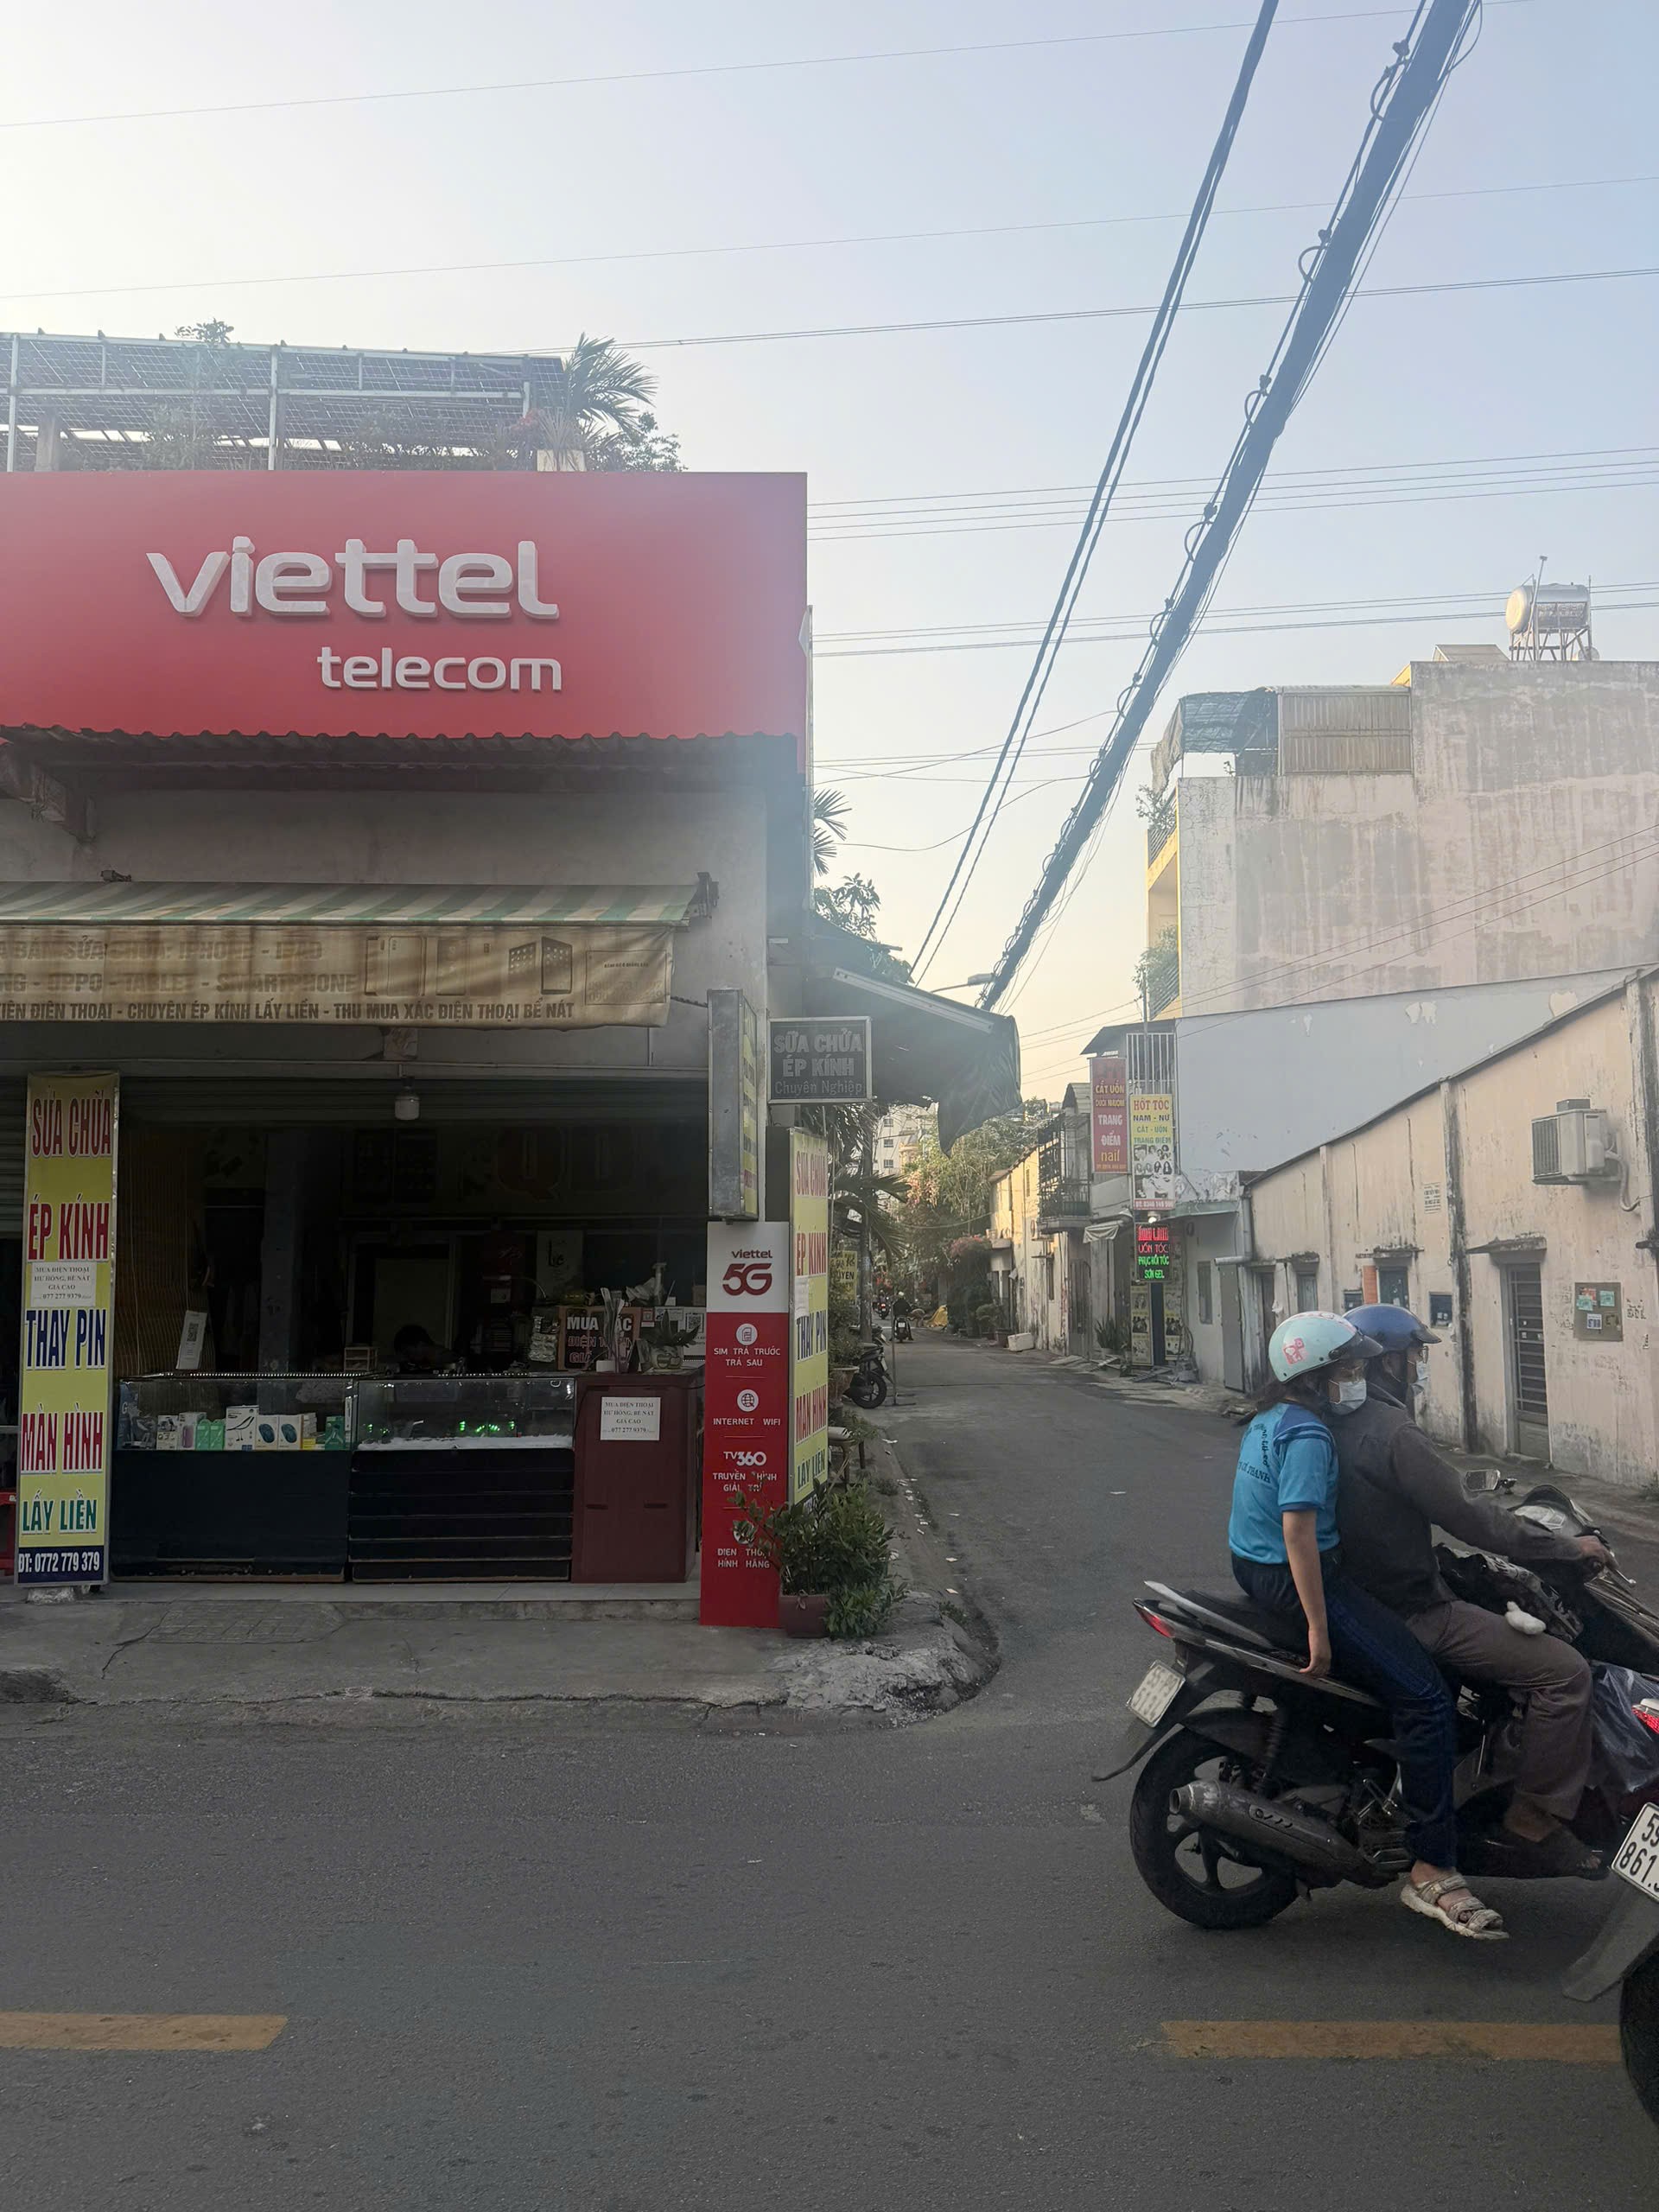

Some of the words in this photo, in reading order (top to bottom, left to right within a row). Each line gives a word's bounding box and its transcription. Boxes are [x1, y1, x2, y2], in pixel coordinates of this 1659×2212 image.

[146, 536, 559, 619] viettel
[317, 647, 562, 690] telecom
[127, 1001, 187, 1020] CHUYÊN
[191, 1000, 210, 1019] ÉP
[214, 1000, 251, 1019] KÍNH
[255, 997, 283, 1019] LẤY
[334, 1003, 361, 1019] THU
[366, 1003, 399, 1019] MUA
[404, 1000, 435, 1019] XÁC
[438, 1001, 473, 1022] ĐIỆN
[477, 1003, 519, 1023] THOẠI
[546, 999, 575, 1019] NÁT
[782, 1054, 807, 1077] ÉP
[811, 1053, 855, 1077] KÍNH
[774, 1080, 817, 1096] Chuyên
[822, 1079, 862, 1096] Nghiệp
[1097, 1114, 1122, 1126] TRANG
[1101, 1148, 1120, 1162] nail
[28, 1193, 52, 1261] ÉP
[58, 1192, 110, 1261] KÍNH
[732, 1249, 773, 1259] viettel
[796, 1225, 806, 1276] ÉP
[722, 1262, 772, 1296] 5G
[567, 1317, 599, 1331] MUA
[25, 1309, 71, 1370] THAY
[75, 1308, 106, 1369] PIN
[714, 1347, 728, 1356] SIM
[733, 1345, 749, 1355] TRẢ
[753, 1345, 780, 1356] TRƯỚC
[747, 1358, 763, 1367] SAU
[713, 1417, 754, 1426] INTERNET
[21, 1403, 57, 1473] MÀN
[61, 1402, 103, 1472] HÌNH
[723, 1451, 767, 1466] TV360
[712, 1468, 746, 1480] TRUYỀN
[22, 1489, 54, 1535] LẤY
[59, 1489, 97, 1534] LIỀN
[35, 1552, 58, 1573] 0772
[60, 1552, 79, 1573] 779
[81, 1551, 99, 1572] 379
[746, 1548, 771, 1559] THOI
[1620, 1841, 1659, 1892] 861.
